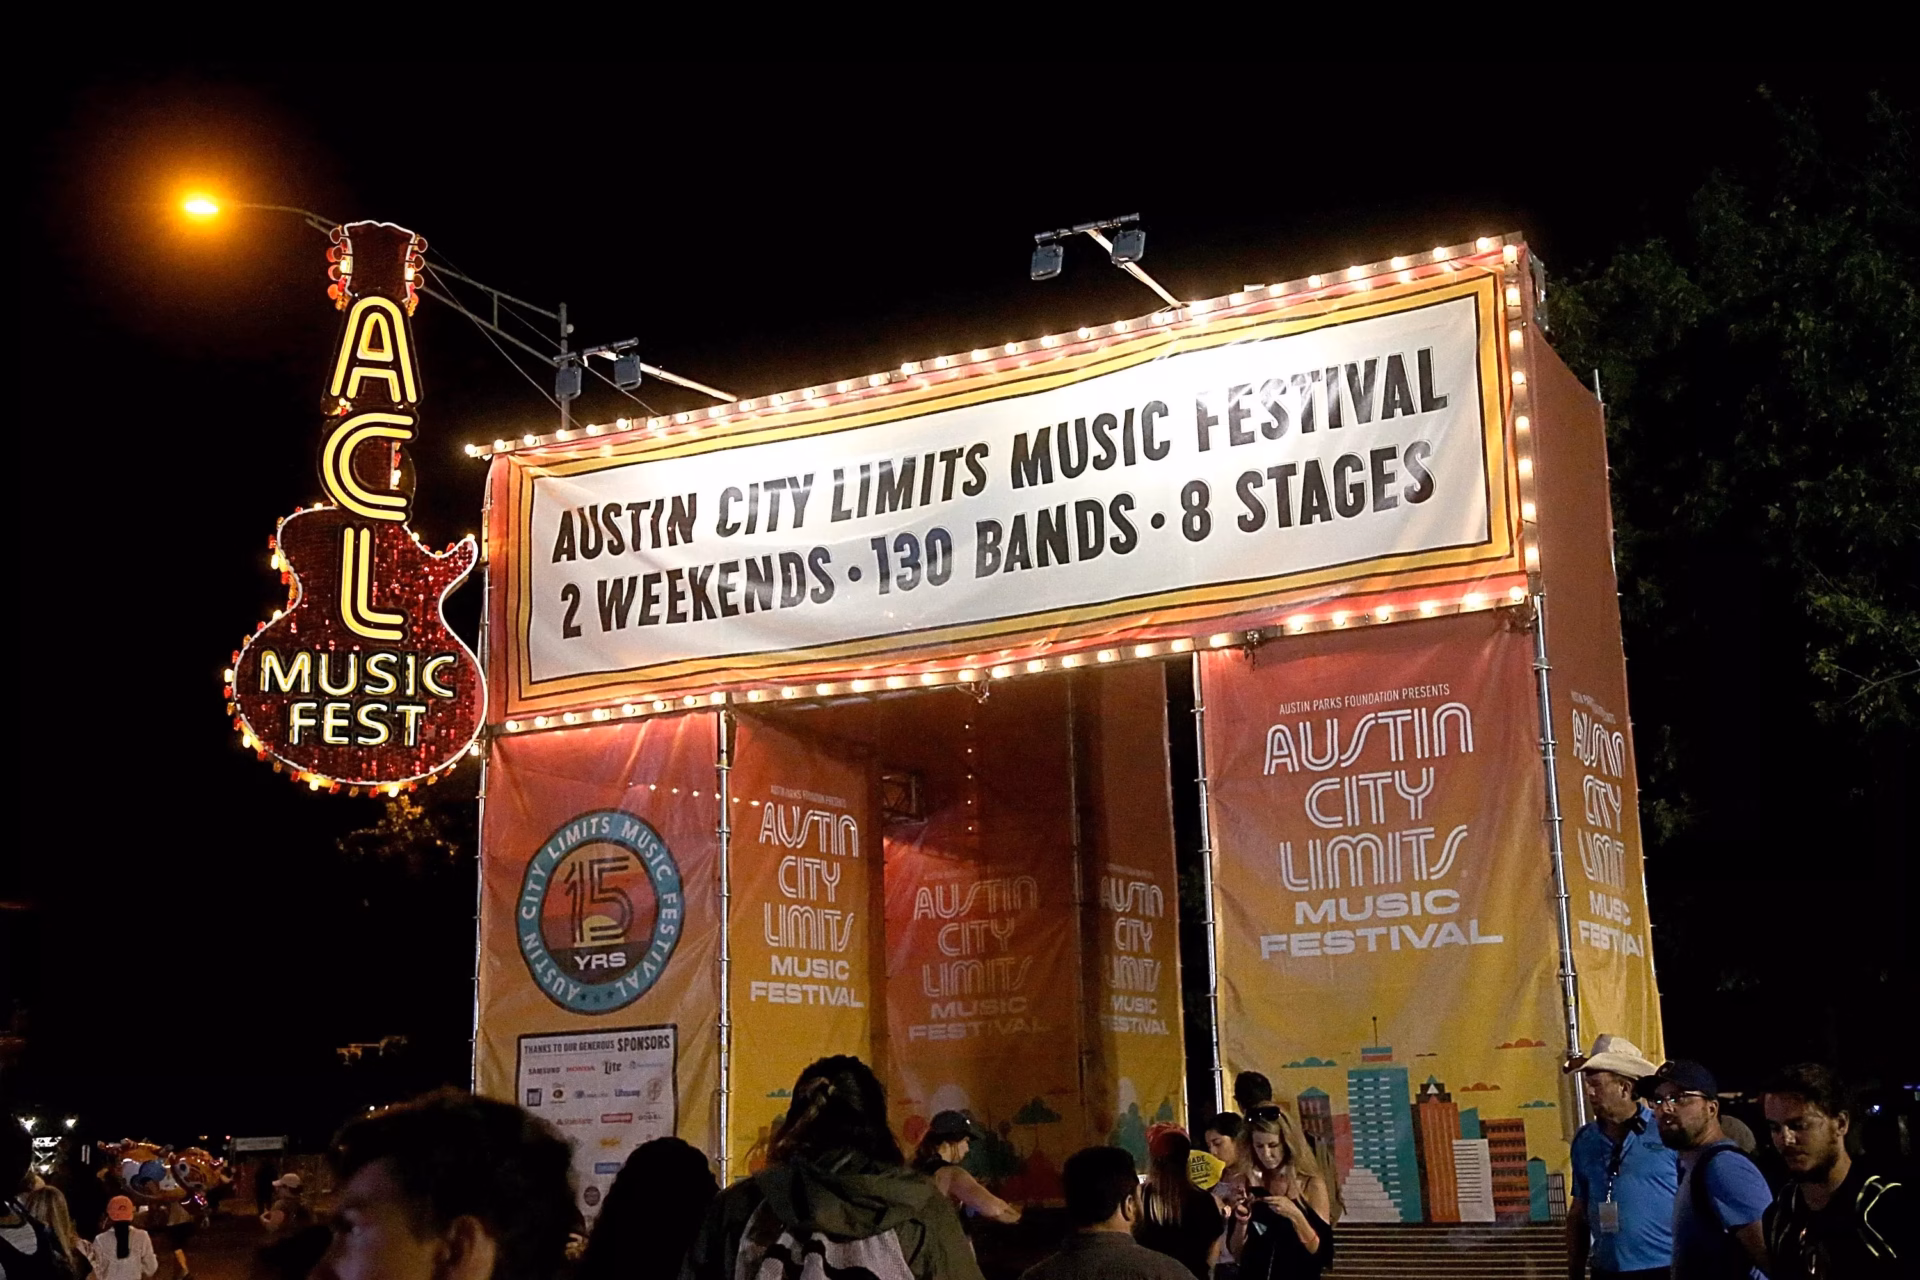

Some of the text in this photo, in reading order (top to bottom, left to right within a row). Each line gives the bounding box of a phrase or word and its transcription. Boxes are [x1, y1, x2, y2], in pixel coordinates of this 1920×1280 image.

[322, 296, 418, 641] ACL
[552, 345, 1449, 564] AUSTIN CITY LIMITS MUSIC FESTIVAL
[560, 440, 1436, 639] 2 WEEKENDS 130 BANDS 8 STAGES
[260, 650, 455, 698] MUSIC
[1279, 683, 1450, 715] AUSTIN PARKS FOUNDATION PRESENTS
[289, 702, 426, 747] FEST
[1263, 702, 1475, 776] AUSTIN
[1572, 708, 1625, 778] AUSTIN
[1304, 766, 1435, 829] CITY
[1583, 774, 1622, 833] CITY
[547, 816, 610, 860] LIMITS
[620, 820, 672, 881] MUSIC
[759, 801, 859, 857] AUSTIN
[778, 855, 841, 903] CITY
[1279, 824, 1468, 893] LIMITS
[1577, 827, 1625, 892] LIMIT
[521, 862, 546, 919] CITY
[564, 856, 634, 943] 15
[913, 875, 1038, 921] AUSTIN
[1101, 876, 1164, 918] AUSTIN
[1294, 889, 1460, 926] MUSIC
[1589, 890, 1631, 926] MUSC
[614, 892, 677, 998] FESTIVAL
[764, 902, 854, 953] LIMITS
[937, 917, 1015, 957] CITY
[1114, 917, 1153, 953] CITY
[1259, 918, 1504, 960] FESTIVAL
[524, 932, 581, 1001] AUSTIN
[574, 952, 627, 970] YRS
[771, 954, 850, 981] MUSIC
[922, 955, 1033, 998] LIMITS
[1104, 955, 1162, 992] LIMITS
[750, 981, 864, 1008] FESTIVAL
[930, 996, 1027, 1020] MUSIC
[1110, 995, 1157, 1015] MUSIC
[524, 1035, 670, 1054] THANKS TO OUR GENEROUS SPONSORS
[908, 1017, 1051, 1041] FESTIVAL
[1101, 1015, 1170, 1036] FESTIVAL
[1189, 1155, 1206, 1163] ADE
